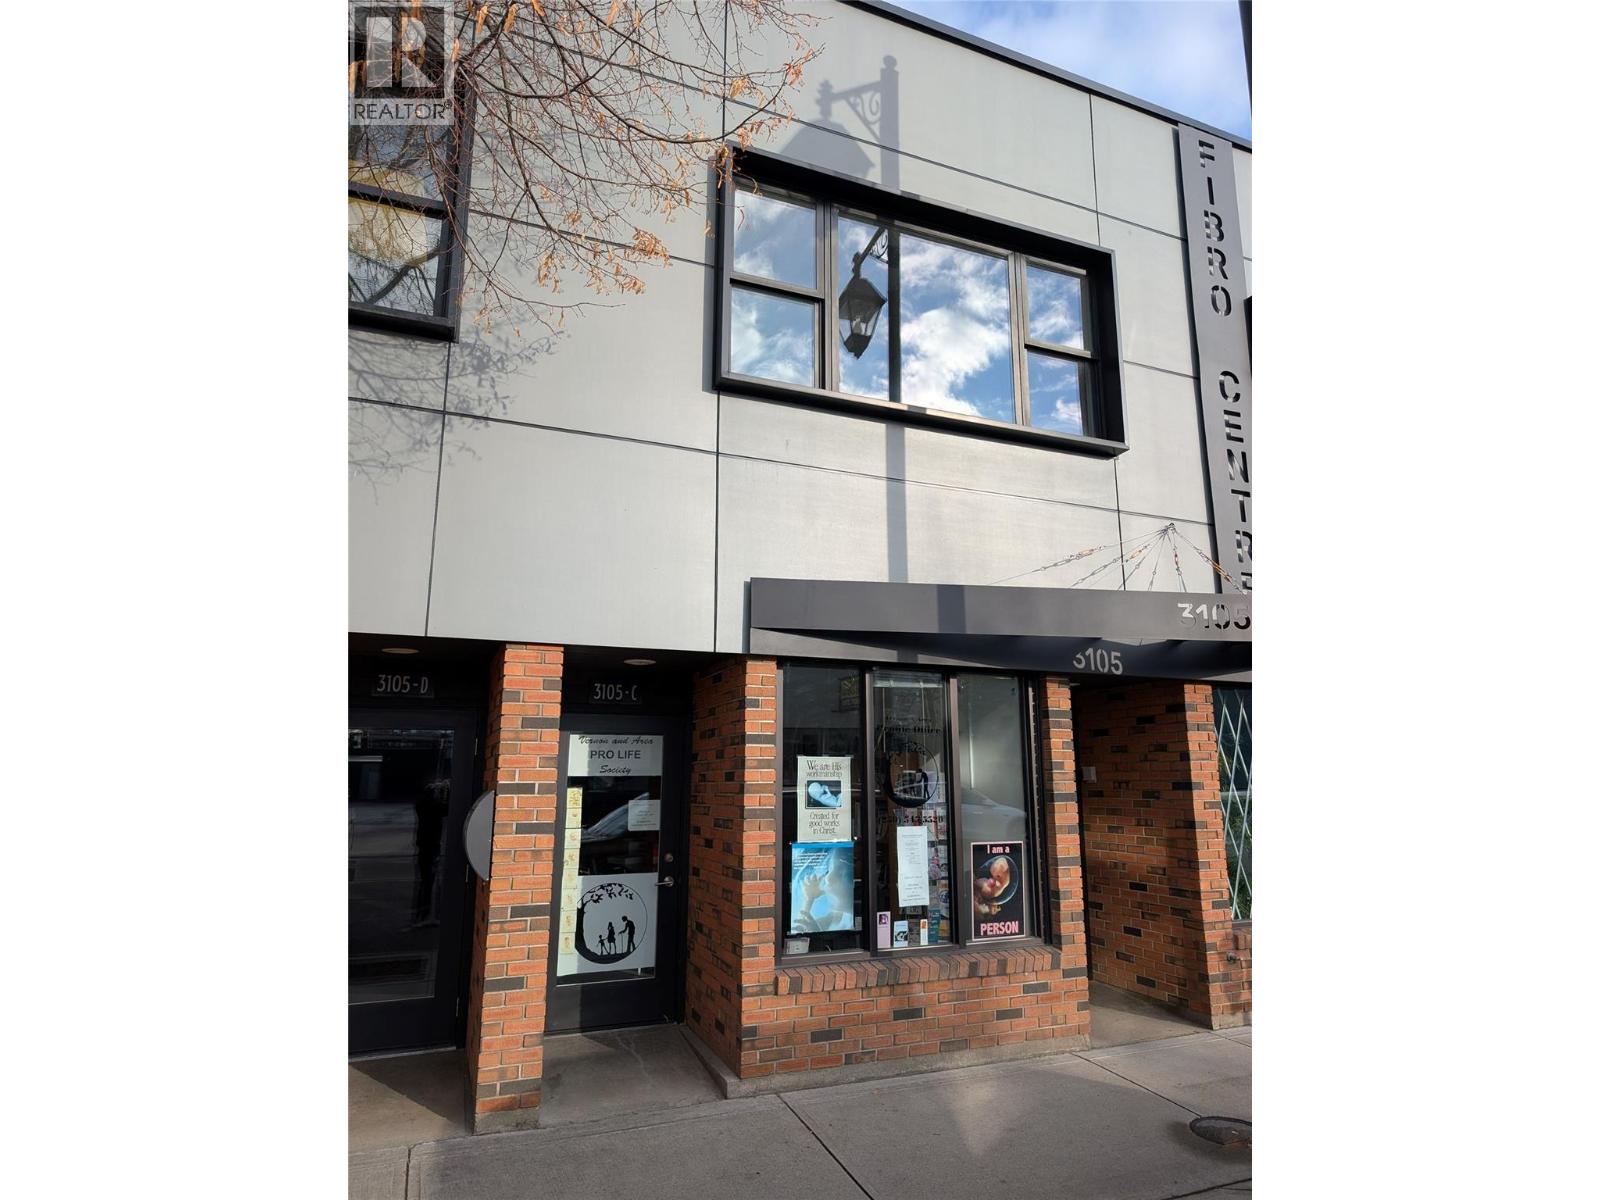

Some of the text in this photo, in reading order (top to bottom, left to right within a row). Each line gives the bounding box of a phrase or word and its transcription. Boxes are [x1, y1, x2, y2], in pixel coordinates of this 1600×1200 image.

[1198, 139, 1232, 317] FIBRO
[1177, 602, 1251, 630] 3105
[1073, 647, 1123, 675] 3105
[376, 674, 429, 693] 3105-D
[593, 683, 639, 700] 3105-C
[578, 735, 655, 745] Vernon and Area
[590, 750, 641, 759] PRO LIFE
[599, 764, 632, 775] Society
[806, 760, 819, 771] We
[819, 763, 830, 771] are
[809, 811, 840, 820] Created for
[808, 820, 823, 828] good
[992, 846, 1004, 854] am
[980, 921, 1019, 936] PERSON
